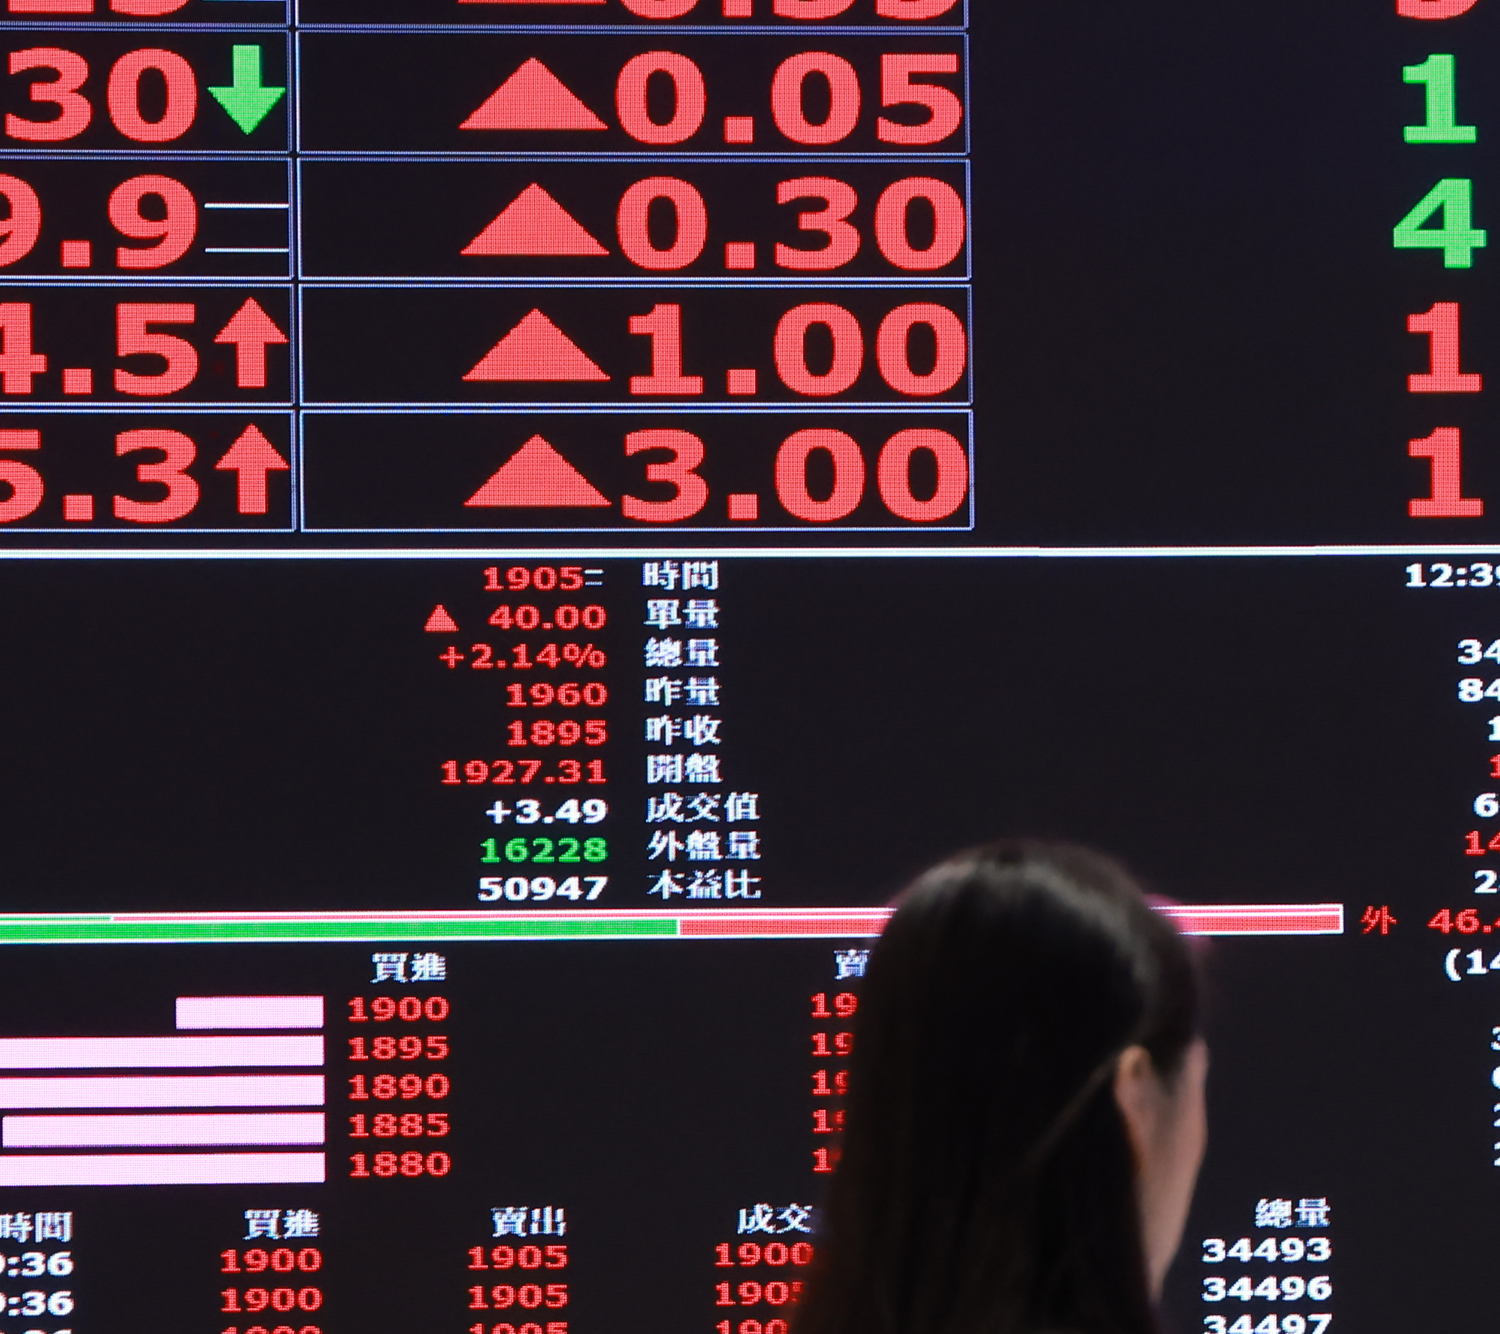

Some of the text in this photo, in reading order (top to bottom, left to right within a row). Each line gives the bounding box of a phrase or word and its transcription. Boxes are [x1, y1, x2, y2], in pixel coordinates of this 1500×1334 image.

[621, 428, 968, 523] 3.00
[1408, 427, 1484, 518] 1
[642, 559, 720, 591] 時間
[488, 604, 606, 630] 40.00
[439, 643, 606, 669] +2.14%
[644, 637, 719, 667] 總量
[506, 682, 608, 707] 1960
[645, 676, 719, 706] 昨量
[508, 720, 608, 746] 1895
[441, 759, 606, 785] 1927.31
[647, 753, 722, 783] 開盤
[486, 799, 607, 824] +3.49
[646, 792, 759, 822] 成交值
[481, 837, 608, 863] 16228
[647, 830, 760, 861] 外盤量
[478, 877, 607, 901] 50947
[648, 869, 761, 899] 本益比
[1361, 906, 1397, 935] 外
[371, 953, 446, 983] 買進
[348, 996, 450, 1022] 1900
[348, 1036, 449, 1061] 1895
[244, 1210, 319, 1240] 買進
[491, 1207, 566, 1237] 賣出
[1255, 1198, 1330, 1228] 總量
[221, 1248, 322, 1273] 1900
[468, 1245, 568, 1270] 1905
[1203, 1238, 1331, 1262] 34493
